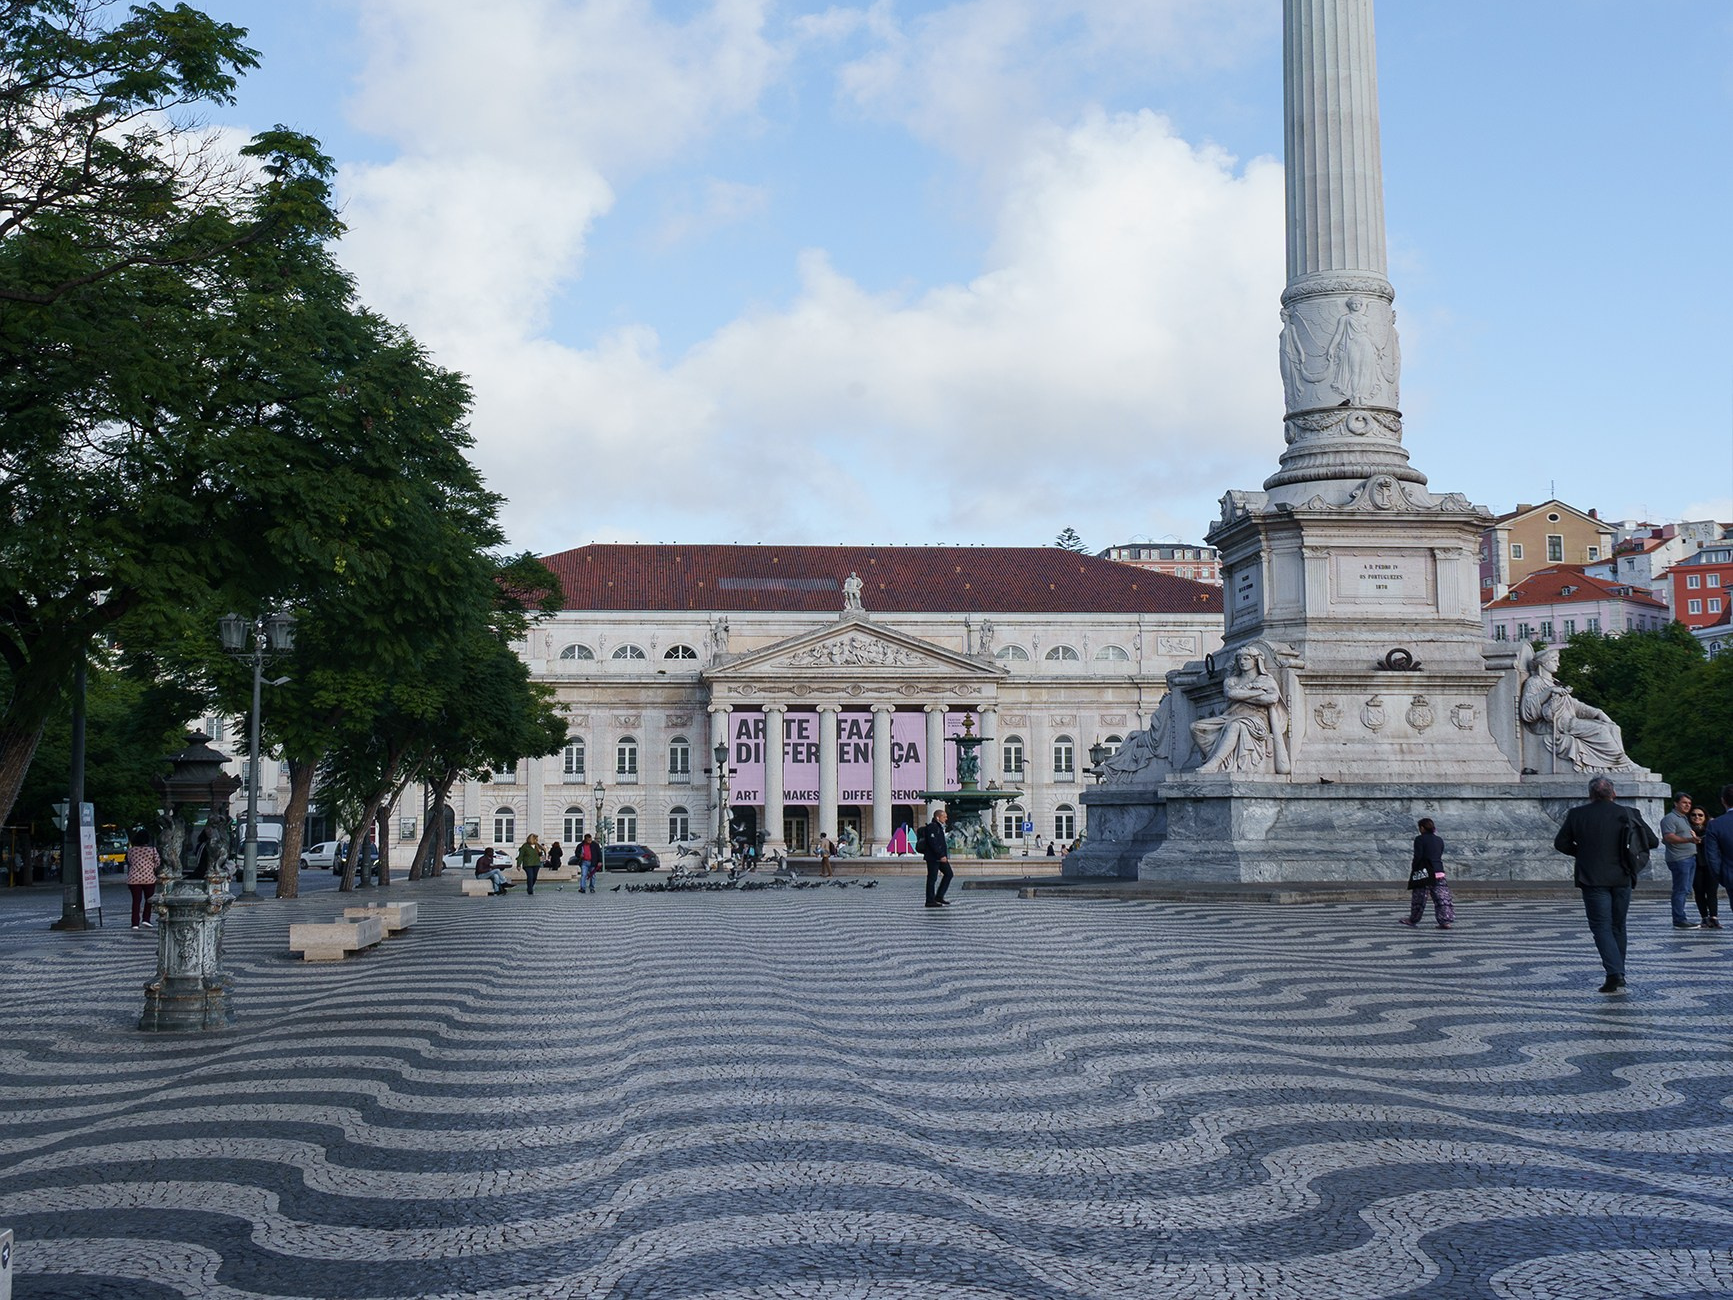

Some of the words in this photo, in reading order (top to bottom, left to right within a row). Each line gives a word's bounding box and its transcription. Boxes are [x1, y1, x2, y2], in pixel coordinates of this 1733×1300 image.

[736, 718, 810, 740] ARTE
[736, 790, 759, 801] ART
[783, 790, 820, 801] MAKES
[1024, 822, 1031, 831] P
